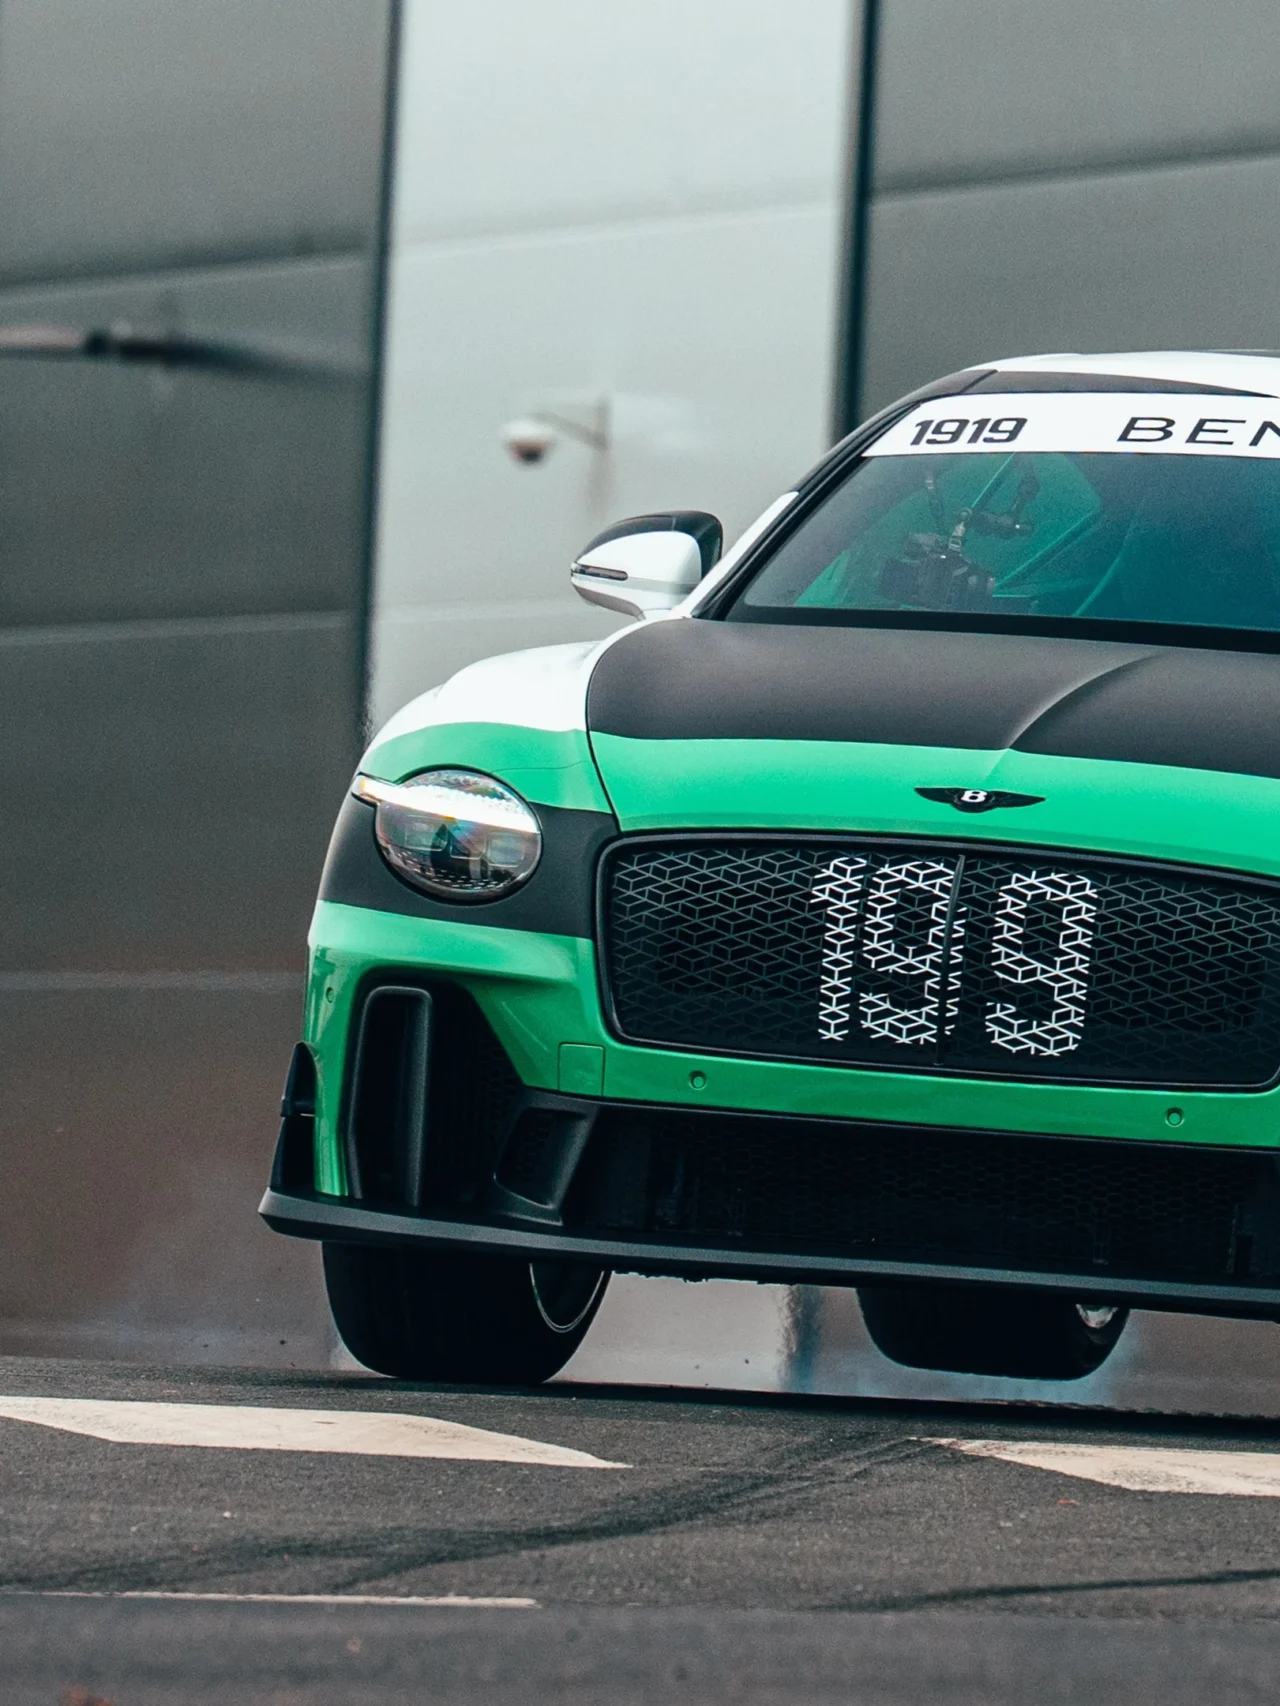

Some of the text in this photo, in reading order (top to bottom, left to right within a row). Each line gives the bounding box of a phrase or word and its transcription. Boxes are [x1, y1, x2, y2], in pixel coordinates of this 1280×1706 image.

[910, 417, 1028, 446] 1919
[960, 789, 988, 803] B
[810, 856, 1098, 1057] 199
